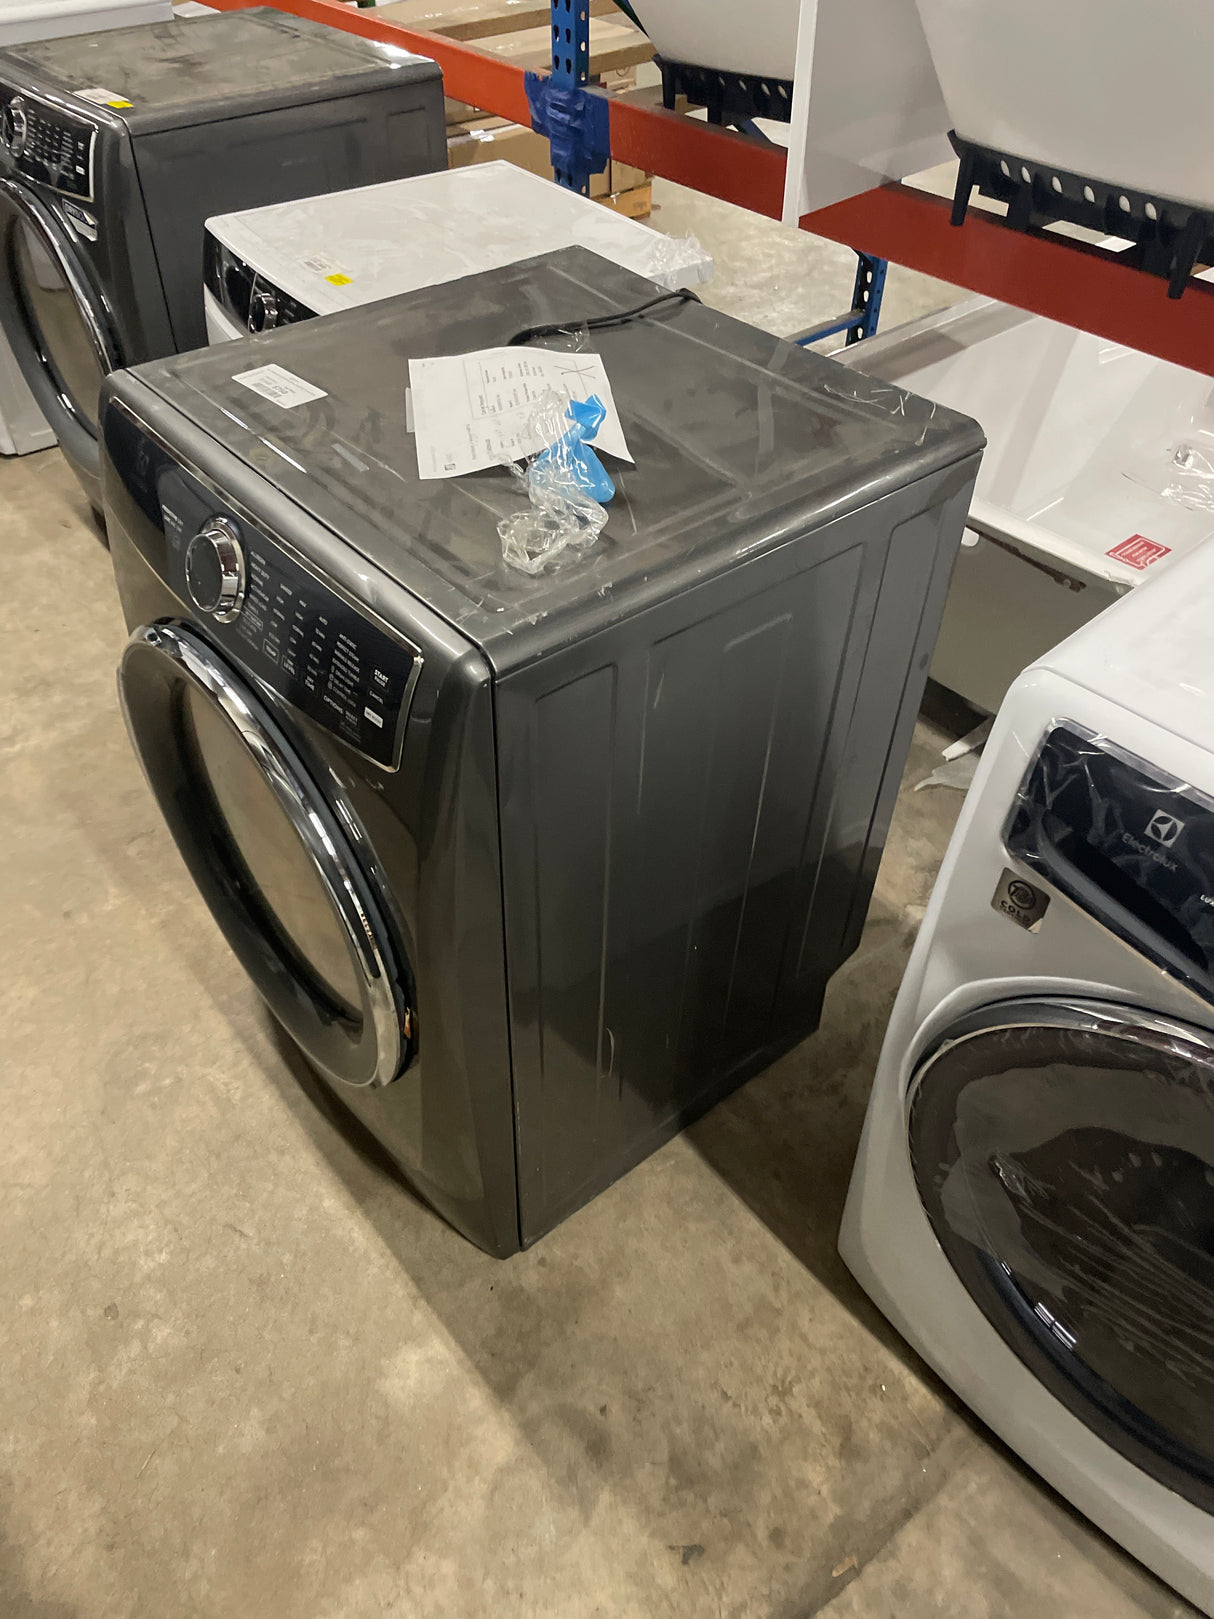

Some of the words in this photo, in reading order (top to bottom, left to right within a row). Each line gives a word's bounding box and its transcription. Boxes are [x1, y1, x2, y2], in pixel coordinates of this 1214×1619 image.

[374, 669, 389, 683] START
[323, 695, 344, 714] OPTIONS
[1121, 832, 1179, 872] Electrolux
[1000, 899, 1032, 922] COLD
